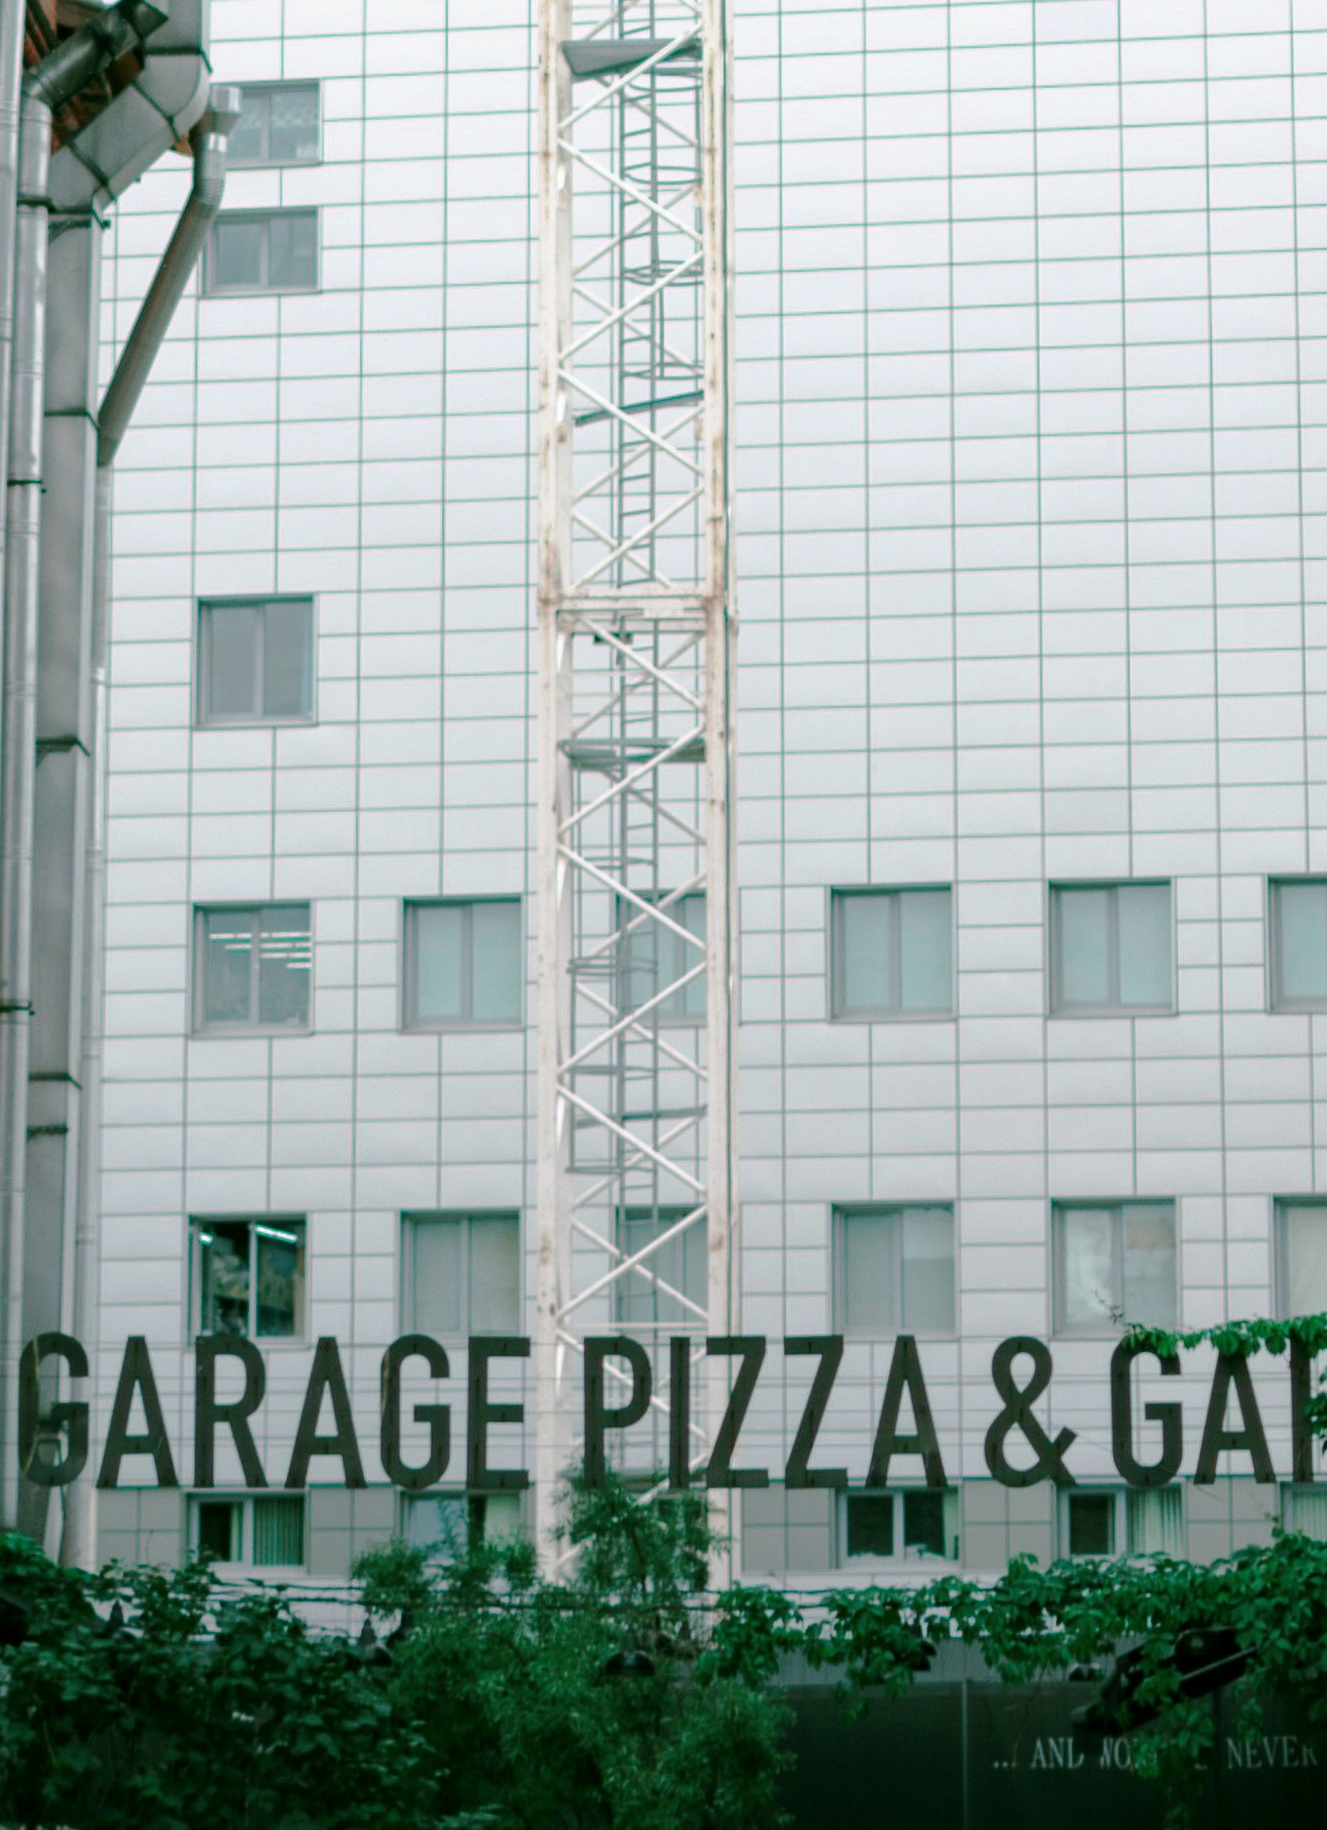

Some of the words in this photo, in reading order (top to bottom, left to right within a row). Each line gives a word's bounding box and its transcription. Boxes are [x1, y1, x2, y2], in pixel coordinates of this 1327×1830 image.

[18, 1331, 531, 1490] GARAGE
[582, 1334, 949, 1490] PIZZA
[983, 1334, 1079, 1489] &
